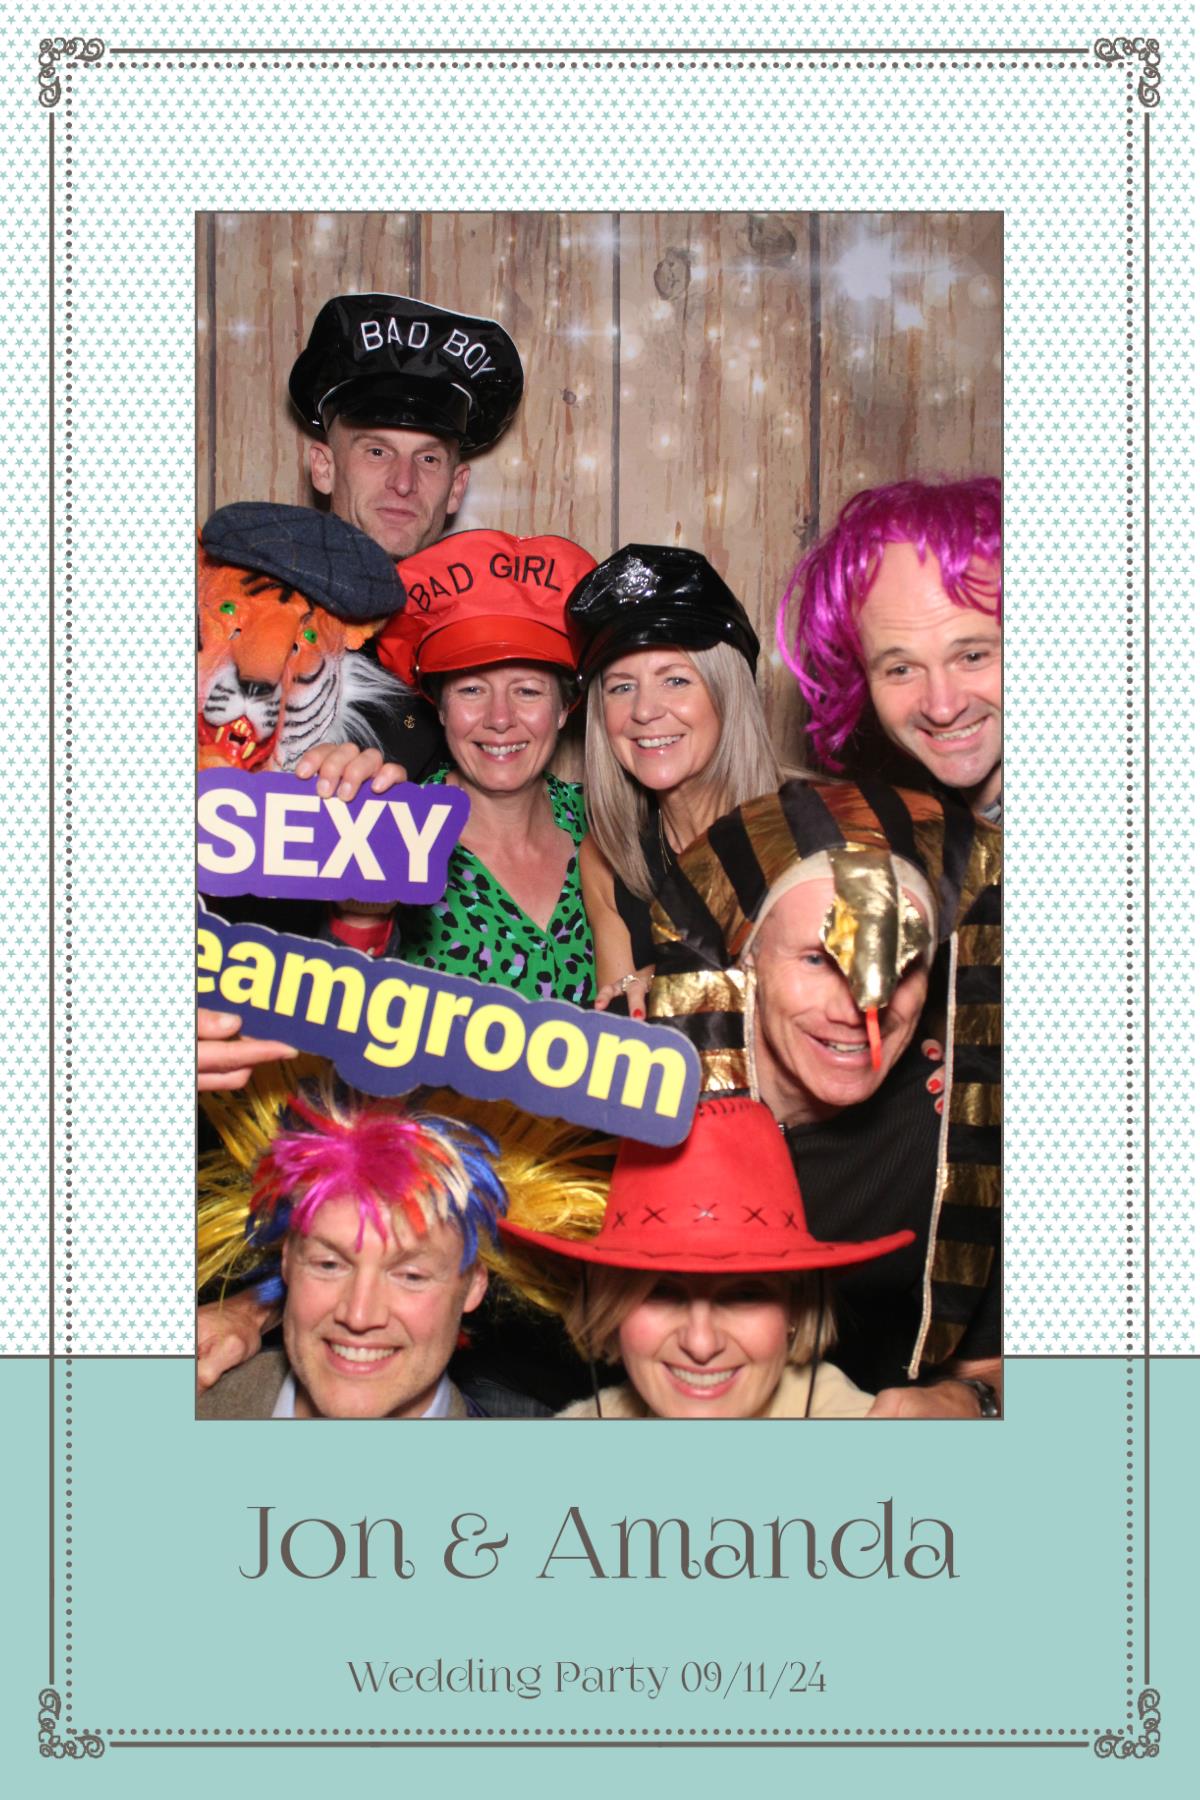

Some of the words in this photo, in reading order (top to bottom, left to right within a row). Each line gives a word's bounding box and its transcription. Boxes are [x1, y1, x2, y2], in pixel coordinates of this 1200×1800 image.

[361, 317, 430, 352] BAD
[443, 329, 497, 378] BOY
[408, 562, 474, 611] BAD
[489, 553, 563, 592] GIRL
[197, 788, 453, 883] SEXY
